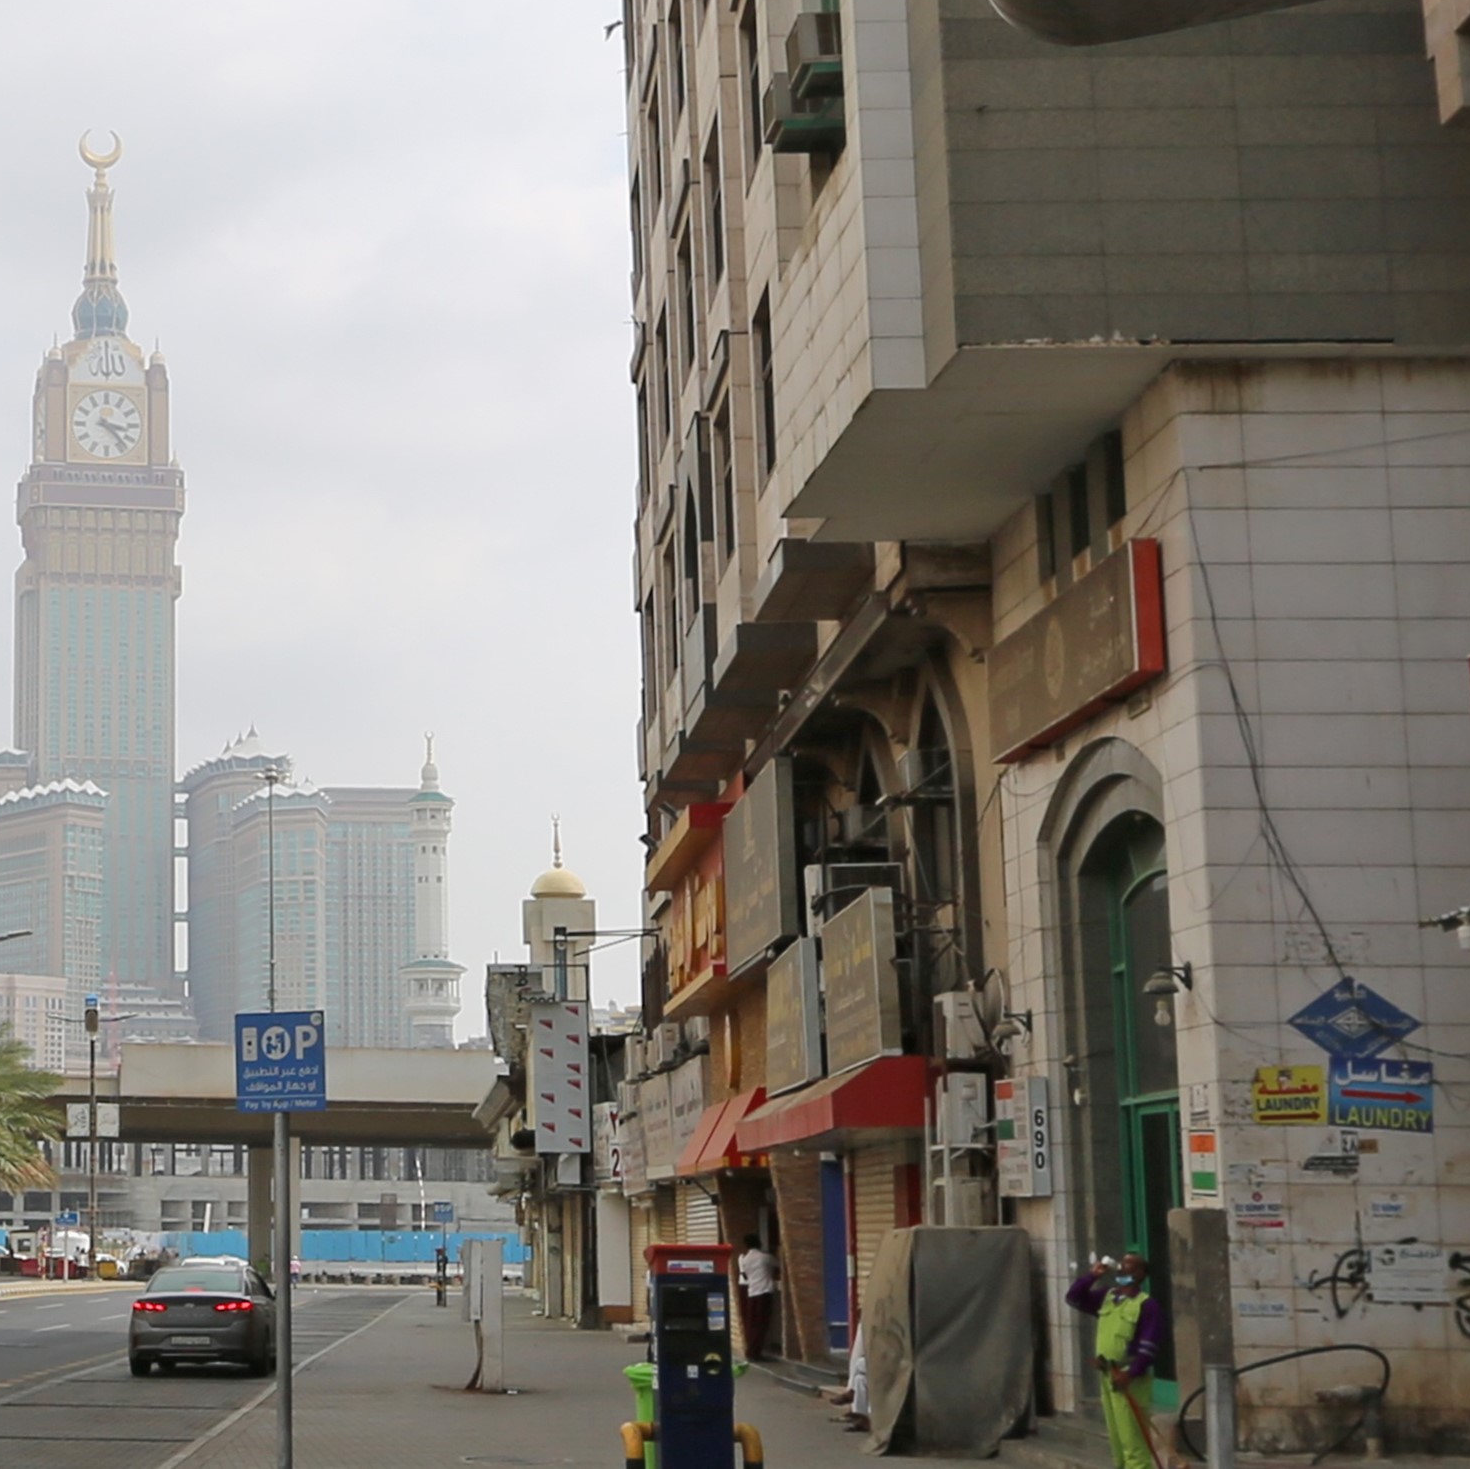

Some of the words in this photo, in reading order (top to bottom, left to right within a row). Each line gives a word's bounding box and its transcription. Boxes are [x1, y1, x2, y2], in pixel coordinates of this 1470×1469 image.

[295, 1025, 318, 1060] P
[1335, 1060, 1430, 1086] مغاسل
[1256, 1096, 1320, 1112] LAUNDRY
[1335, 1104, 1431, 1130] LAUNDRY
[1034, 1109, 1045, 1170] 690
